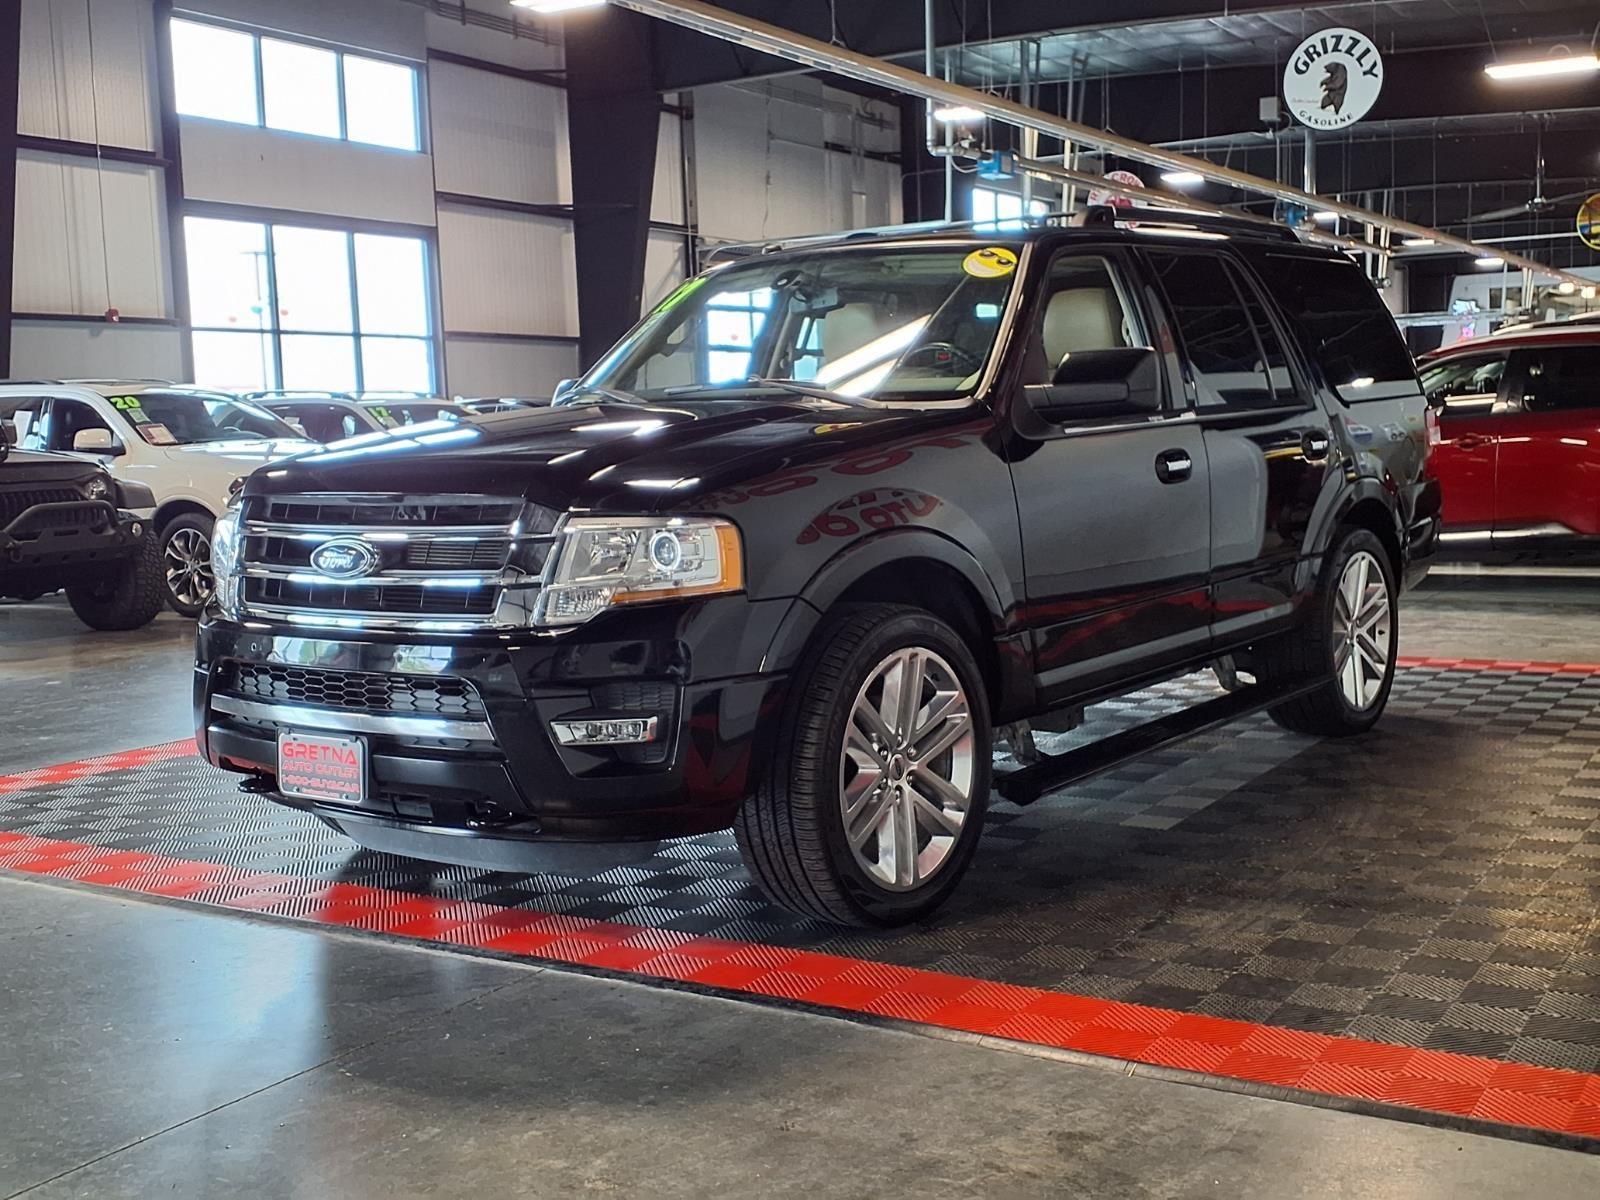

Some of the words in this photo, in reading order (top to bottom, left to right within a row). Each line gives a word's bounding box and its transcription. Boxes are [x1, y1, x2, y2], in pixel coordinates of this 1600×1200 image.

[1294, 34, 1378, 75] GRIZZLY
[1299, 110, 1354, 126] GASOLINE
[110, 396, 141, 410] 20
[282, 742, 358, 766] GRETNA
[283, 760, 313, 773] AUTO
[316, 763, 359, 779] OUTLET
